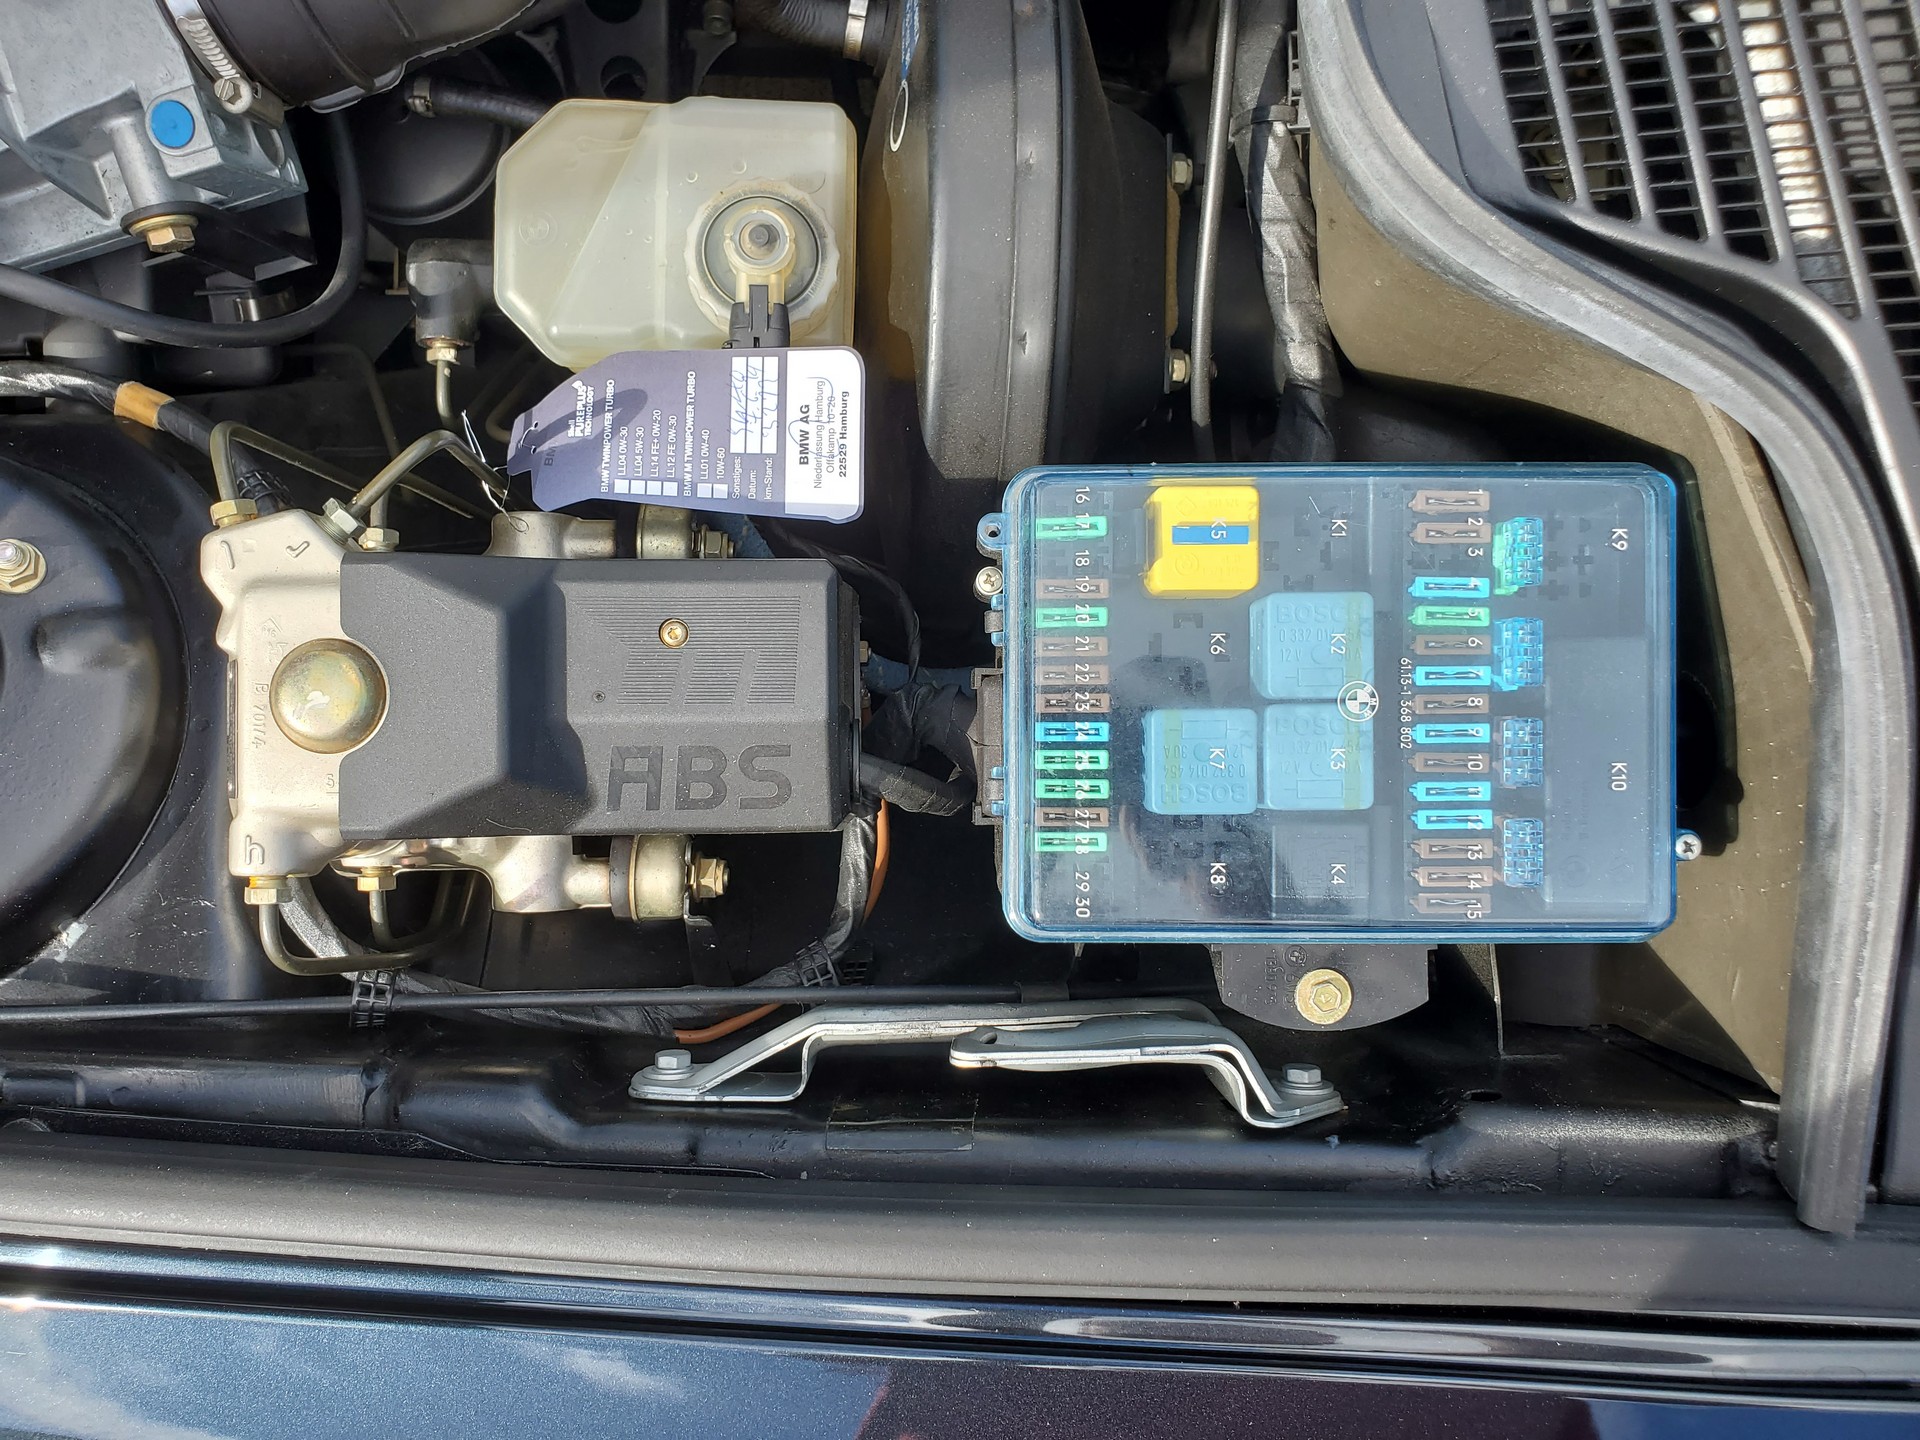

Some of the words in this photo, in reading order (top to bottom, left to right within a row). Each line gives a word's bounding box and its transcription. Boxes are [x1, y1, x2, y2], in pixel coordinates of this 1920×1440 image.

[605, 379, 615, 411] TURBO
[687, 371, 696, 403] TURBO
[575, 385, 587, 437] PUREPLUS
[584, 385, 595, 436] TECHNOLOGY
[815, 380, 826, 423] Hamburg
[827, 396, 836, 424] 10-20
[652, 409, 662, 437] 0W-20
[799, 404, 810, 424] AG
[839, 391, 850, 440] Hamburg
[668, 415, 678, 443] 0W-30
[684, 404, 695, 463] TWINPOWER
[601, 412, 613, 471] TWINPOWER
[618, 426, 629, 454] 0W-30
[635, 427, 644, 454] 5W-30
[651, 438, 660, 455] FE+
[667, 443, 676, 456] FE
[701, 429, 710, 457] 0W-40
[799, 428, 810, 465] BMW
[617, 456, 627, 476] LL04
[634, 456, 643, 477] LL04
[650, 457, 659, 477] LL14
[716, 447, 726, 480] 10W-60
[813, 424, 825, 489] Niederlassung
[839, 442, 847, 478] 22529
[666, 457, 676, 478] LL12
[684, 464, 693, 472] M
[700, 458, 709, 480] LL01
[731, 456, 745, 499] Sonstiges:
[600, 471, 610, 493] BMW
[683, 473, 692, 497] BMW
[748, 469, 757, 500] Datum:
[763, 457, 773, 500] km-Stand:
[1075, 486, 1090, 504] 16
[1467, 488, 1483, 496] 1
[1075, 512, 1090, 528] 17
[1210, 517, 1227, 539] K5
[1331, 519, 1347, 537] K1
[1467, 517, 1483, 526] 2
[1611, 528, 1628, 551] K9
[1075, 550, 1090, 567] 18
[1467, 547, 1483, 557] 3
[1075, 576, 1090, 592] 19
[1075, 604, 1090, 623] 20
[1276, 602, 1360, 624] BOSCH
[1467, 608, 1483, 617] 5
[1075, 636, 1090, 651] 21
[1210, 633, 1226, 655] K6
[1279, 628, 1286, 643] 0
[1290, 628, 1312, 643] 332
[1330, 633, 1346, 655] K2
[1467, 637, 1483, 647] 6
[1075, 664, 1090, 682] 22
[1400, 657, 1412, 696] 61.13-1
[1075, 692, 1090, 711] 23
[1400, 699, 1412, 723] 368
[1467, 697, 1483, 706] 8
[1075, 721, 1090, 741] 24
[1400, 727, 1412, 749] 802
[1467, 728, 1483, 737] 9
[1075, 750, 1090, 771] 25
[1173, 744, 1188, 759] 30
[1209, 748, 1225, 769] K7
[1330, 748, 1346, 770] K3
[1467, 753, 1483, 771] 10
[606, 744, 792, 811] ABS
[1163, 764, 1184, 779] 454
[1188, 764, 1208, 779] 014
[1239, 764, 1246, 779] 0
[1611, 762, 1628, 791] K10
[1075, 780, 1090, 799] 26
[1160, 783, 1249, 805] BOSCH
[1075, 810, 1090, 829] 27
[1467, 815, 1483, 830] 12
[1075, 835, 1090, 854] 28
[1467, 843, 1483, 860] 13
[1075, 872, 1090, 892] 29
[1210, 862, 1226, 884] K8
[1330, 863, 1346, 885] K4
[1467, 872, 1483, 890] 14
[1075, 897, 1090, 918] 30
[1467, 900, 1483, 919] 15
